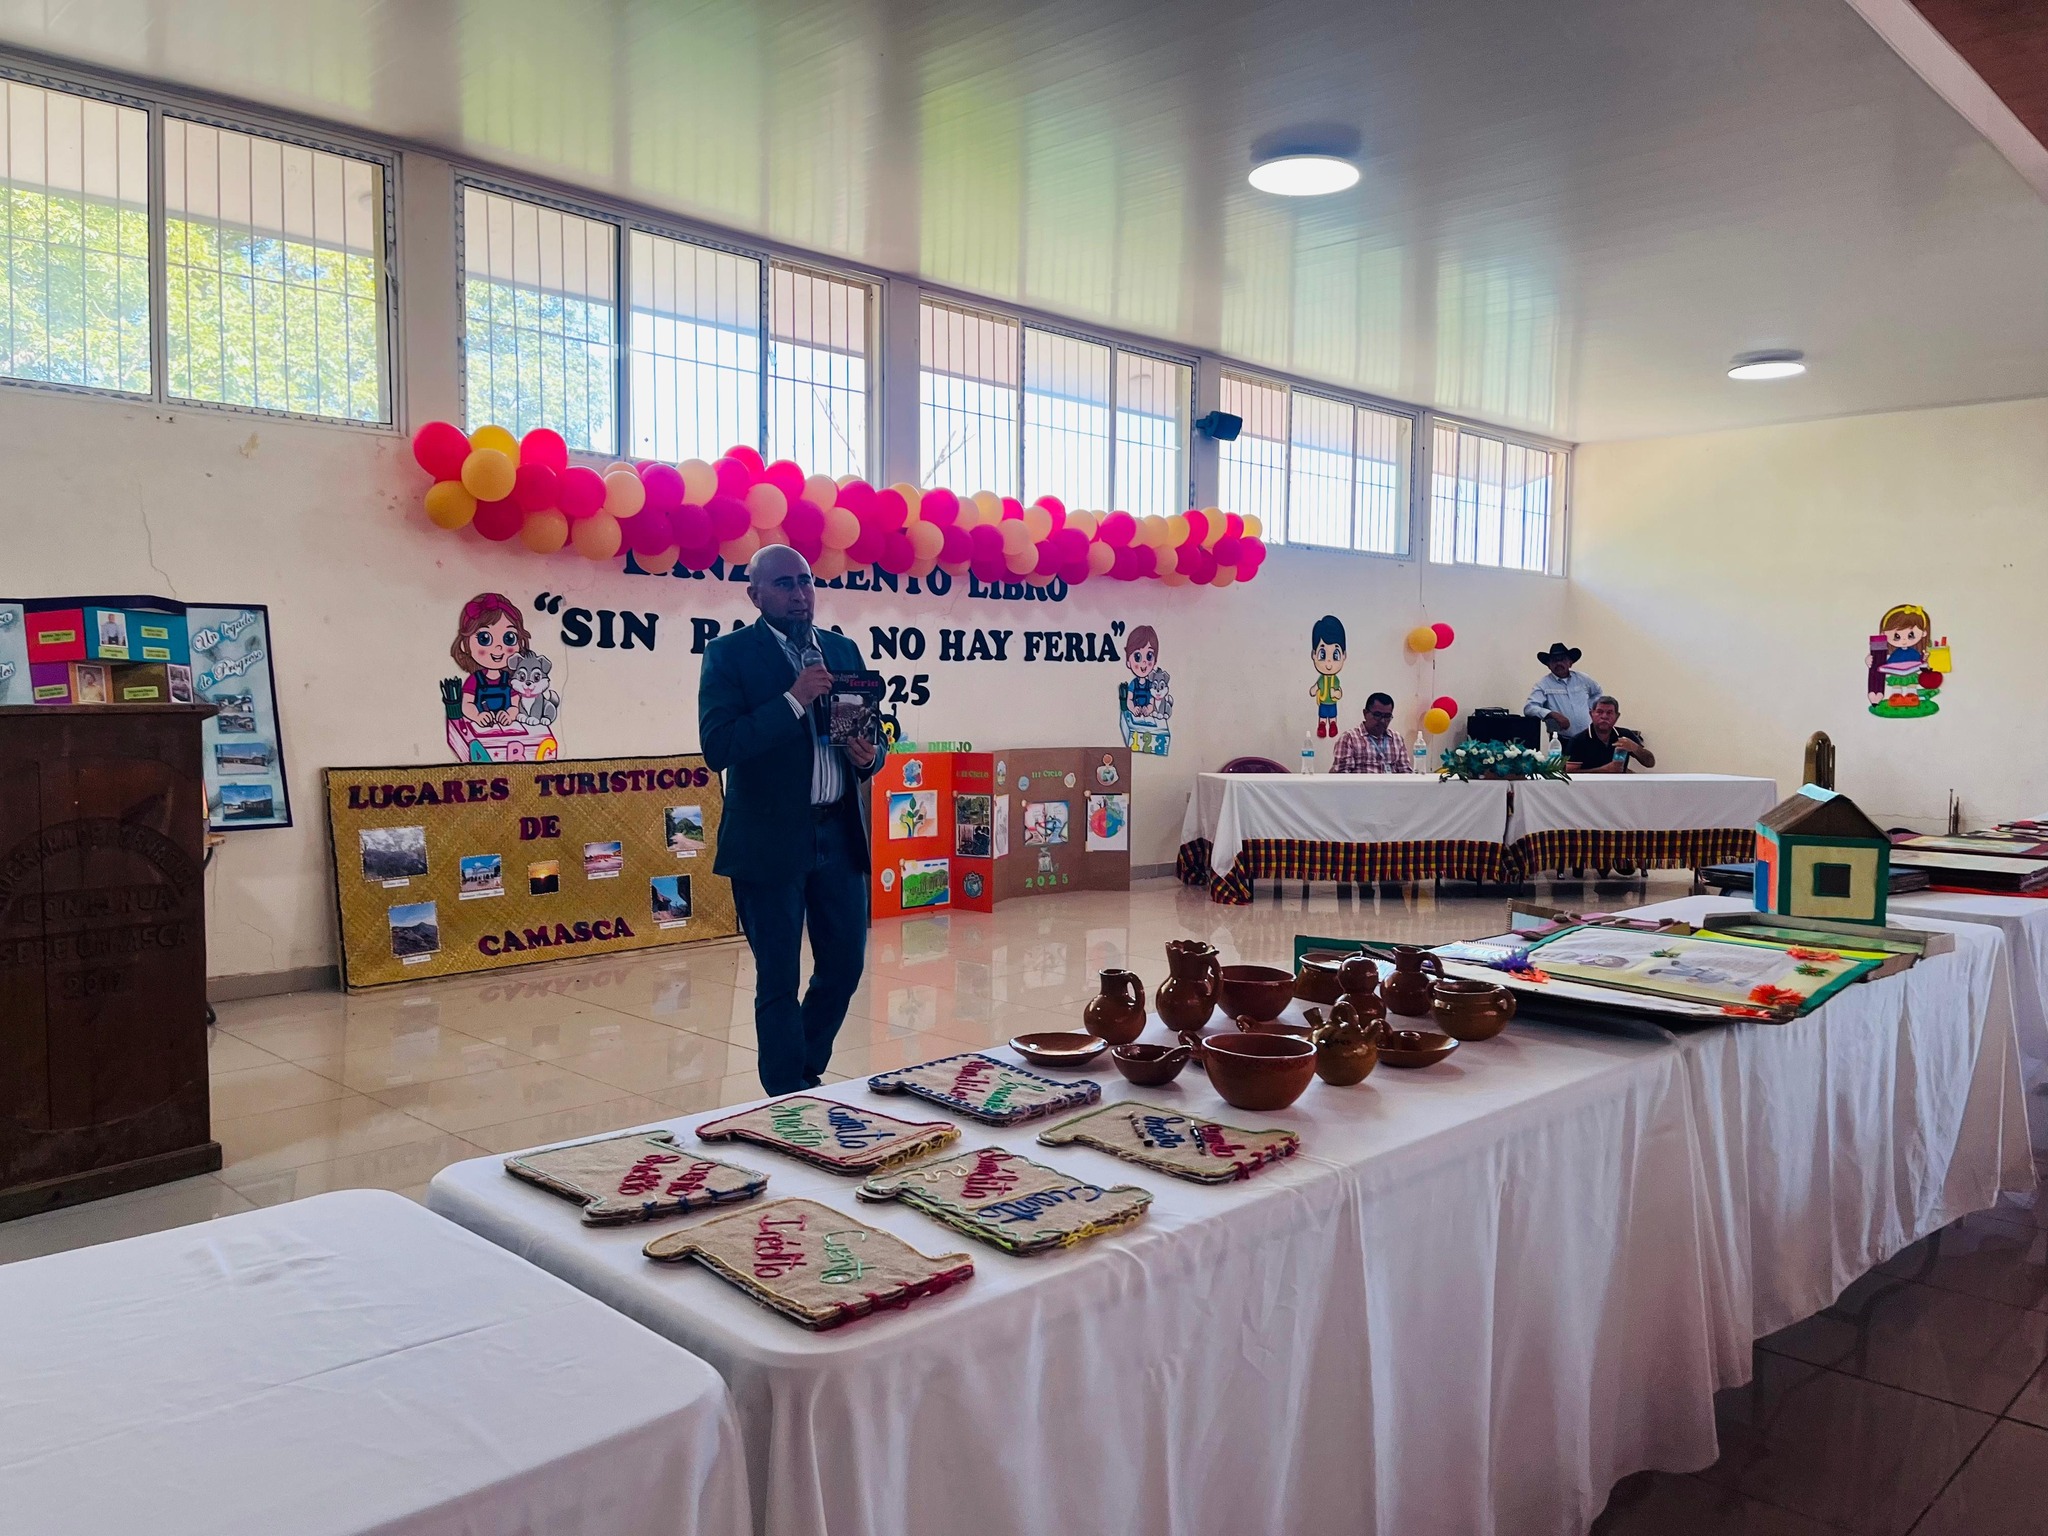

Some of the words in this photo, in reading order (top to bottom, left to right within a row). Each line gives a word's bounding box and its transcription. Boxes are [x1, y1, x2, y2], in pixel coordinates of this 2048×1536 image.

[869, 626, 926, 660] NO
[939, 629, 1013, 661] HAY
[215, 650, 262, 680] Progreso
[928, 741, 972, 752] DIBUJO
[347, 777, 510, 810] LUGARES
[534, 766, 710, 797] TURISTICOS
[519, 815, 562, 841] DE
[478, 917, 635, 956] CAMASCA
[977, 1184, 1101, 1224] Cuento
[819, 1230, 877, 1284] Cuento
